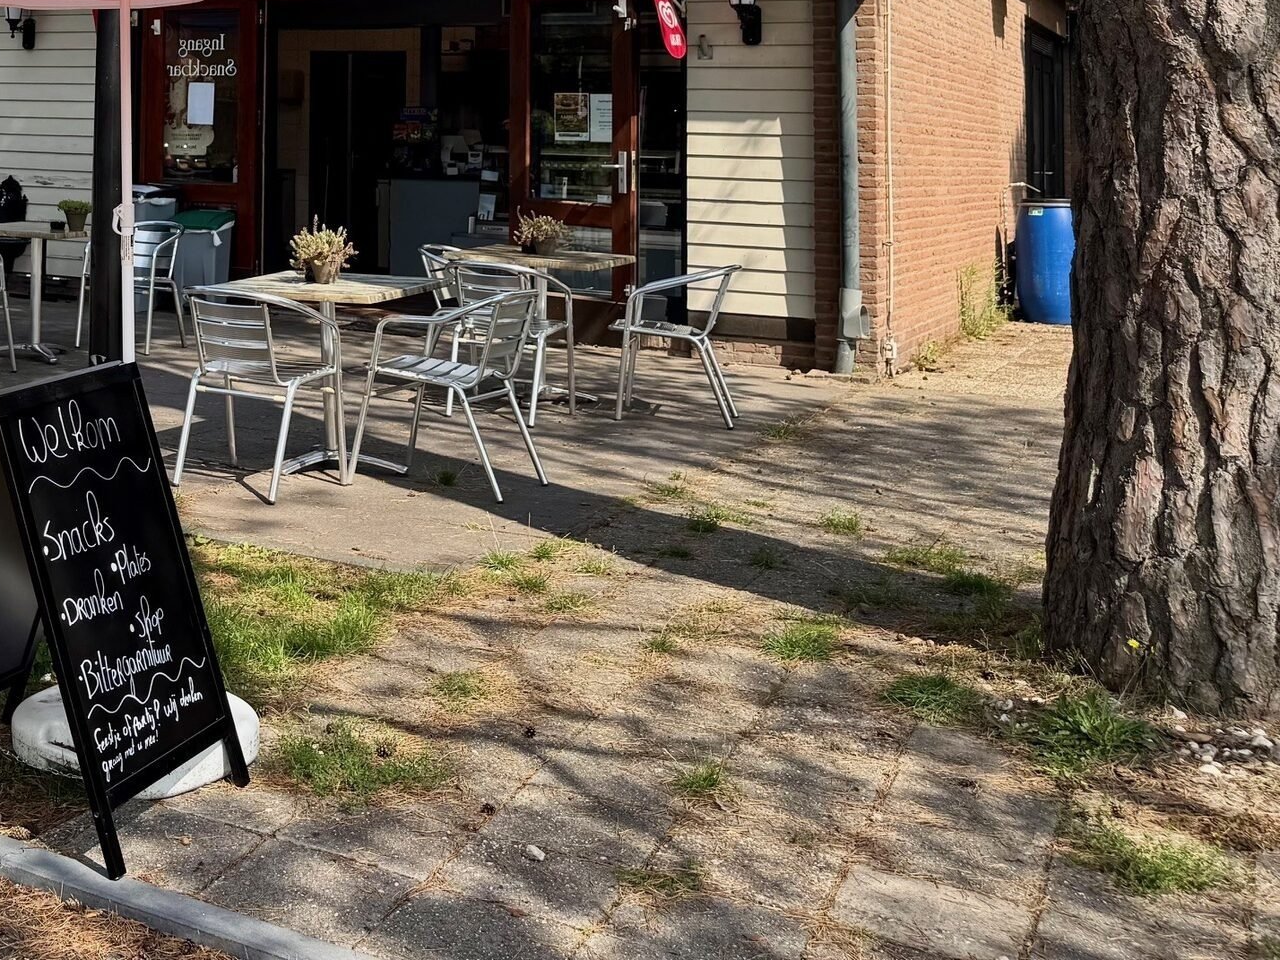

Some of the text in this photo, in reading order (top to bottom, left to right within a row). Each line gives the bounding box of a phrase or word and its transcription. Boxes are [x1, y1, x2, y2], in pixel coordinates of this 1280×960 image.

[18, 399, 121, 464] Welkom
[122, 713, 132, 737] of
[124, 738, 135, 759] met
